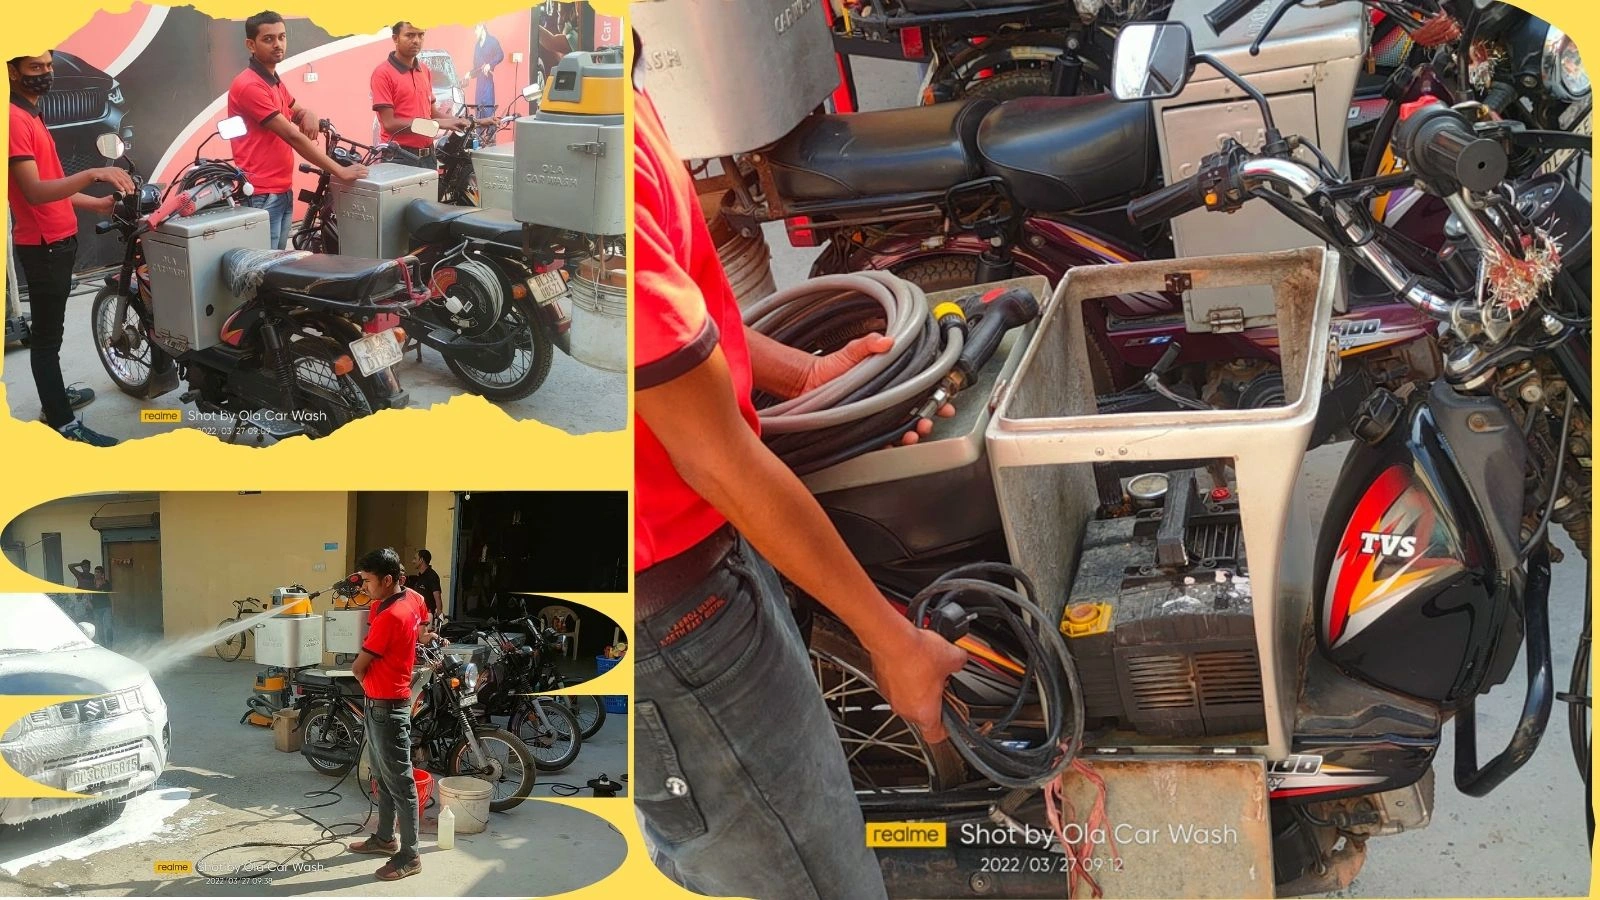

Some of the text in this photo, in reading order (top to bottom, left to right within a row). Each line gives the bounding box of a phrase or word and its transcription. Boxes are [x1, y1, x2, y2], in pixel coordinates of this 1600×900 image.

[601, 21, 612, 41] Car
[542, 163, 564, 175] OLA
[526, 173, 545, 184] CAR
[1360, 532, 1417, 558] TVS
